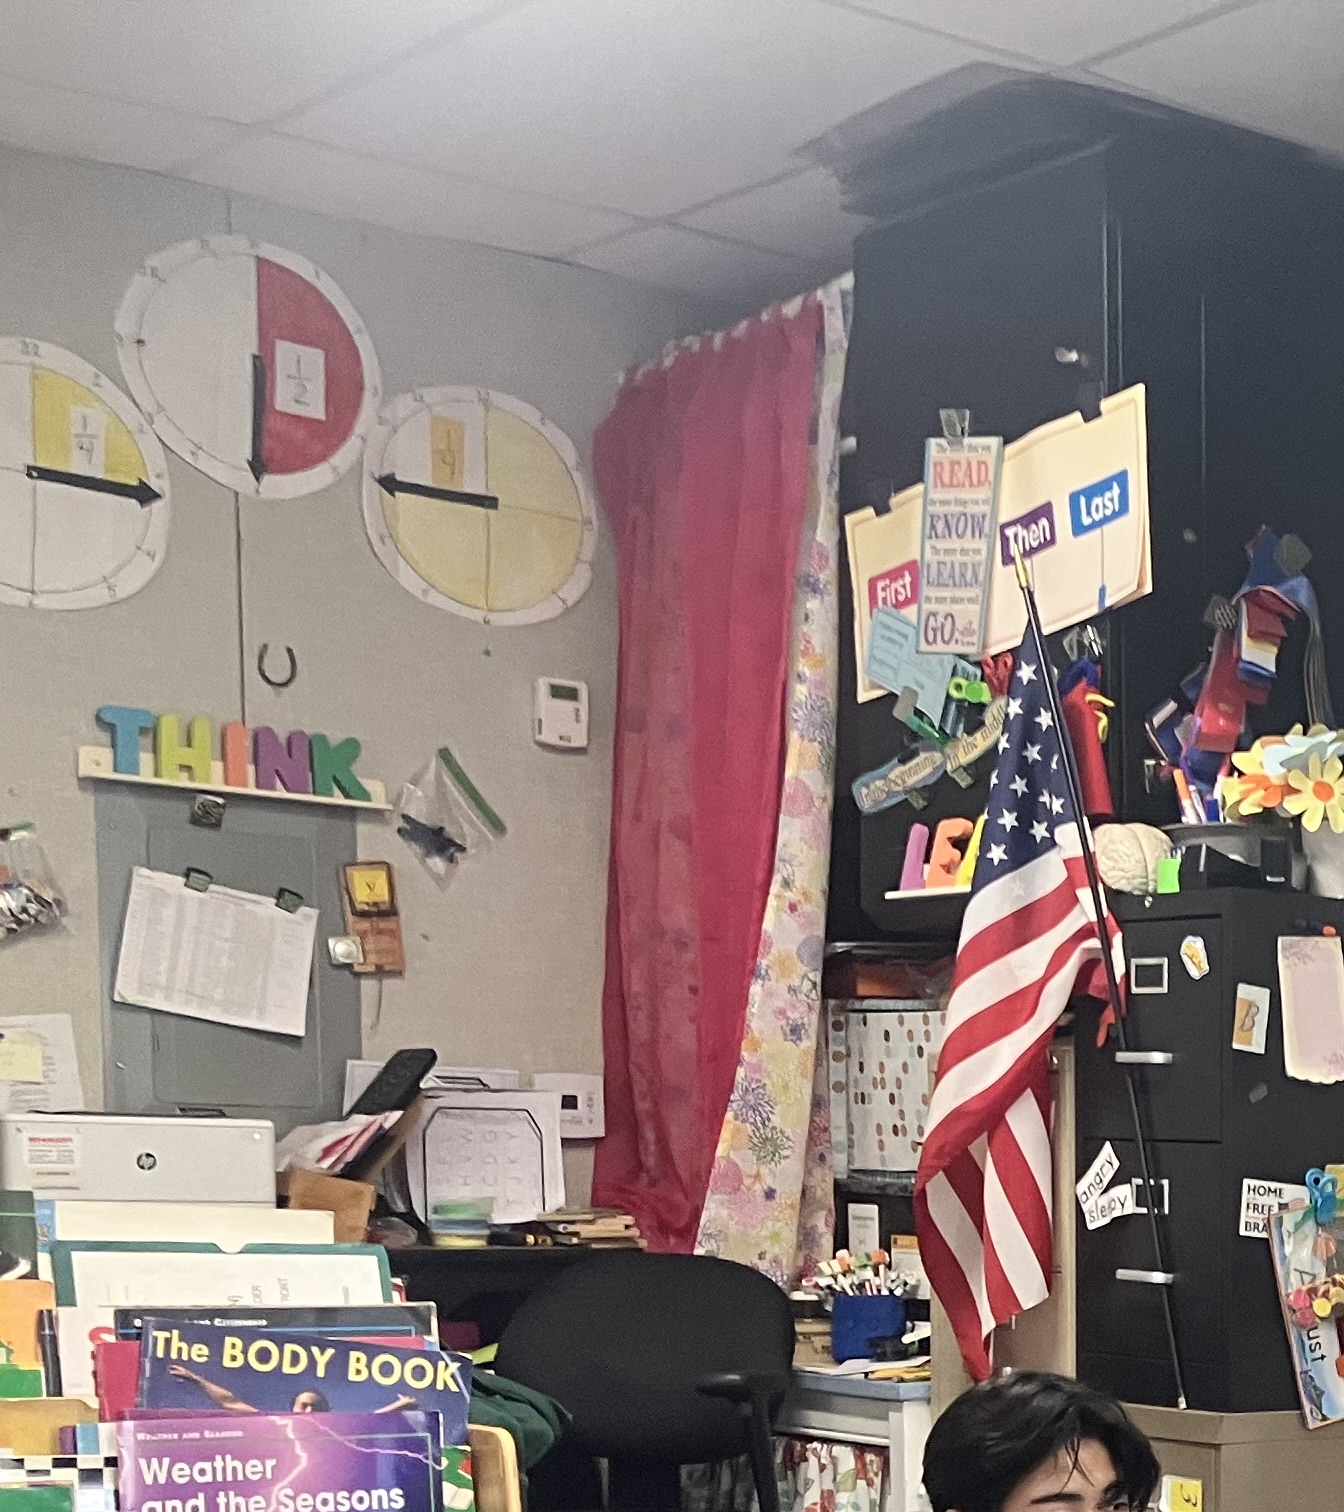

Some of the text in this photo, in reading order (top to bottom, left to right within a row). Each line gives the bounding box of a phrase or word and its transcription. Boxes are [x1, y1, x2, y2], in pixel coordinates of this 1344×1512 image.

[1079, 482, 1121, 526] Last
[1004, 515, 1050, 557] Then
[877, 570, 912, 609] First
[94, 704, 372, 802] THINK
[1240, 1000, 1260, 1032] B
[1080, 1151, 1115, 1205] angry
[1247, 1183, 1285, 1199] HOME
[1244, 1220, 1268, 1234] BRA
[151, 1329, 462, 1393] The BODY BOOK
[138, 1454, 277, 1486] Weather
